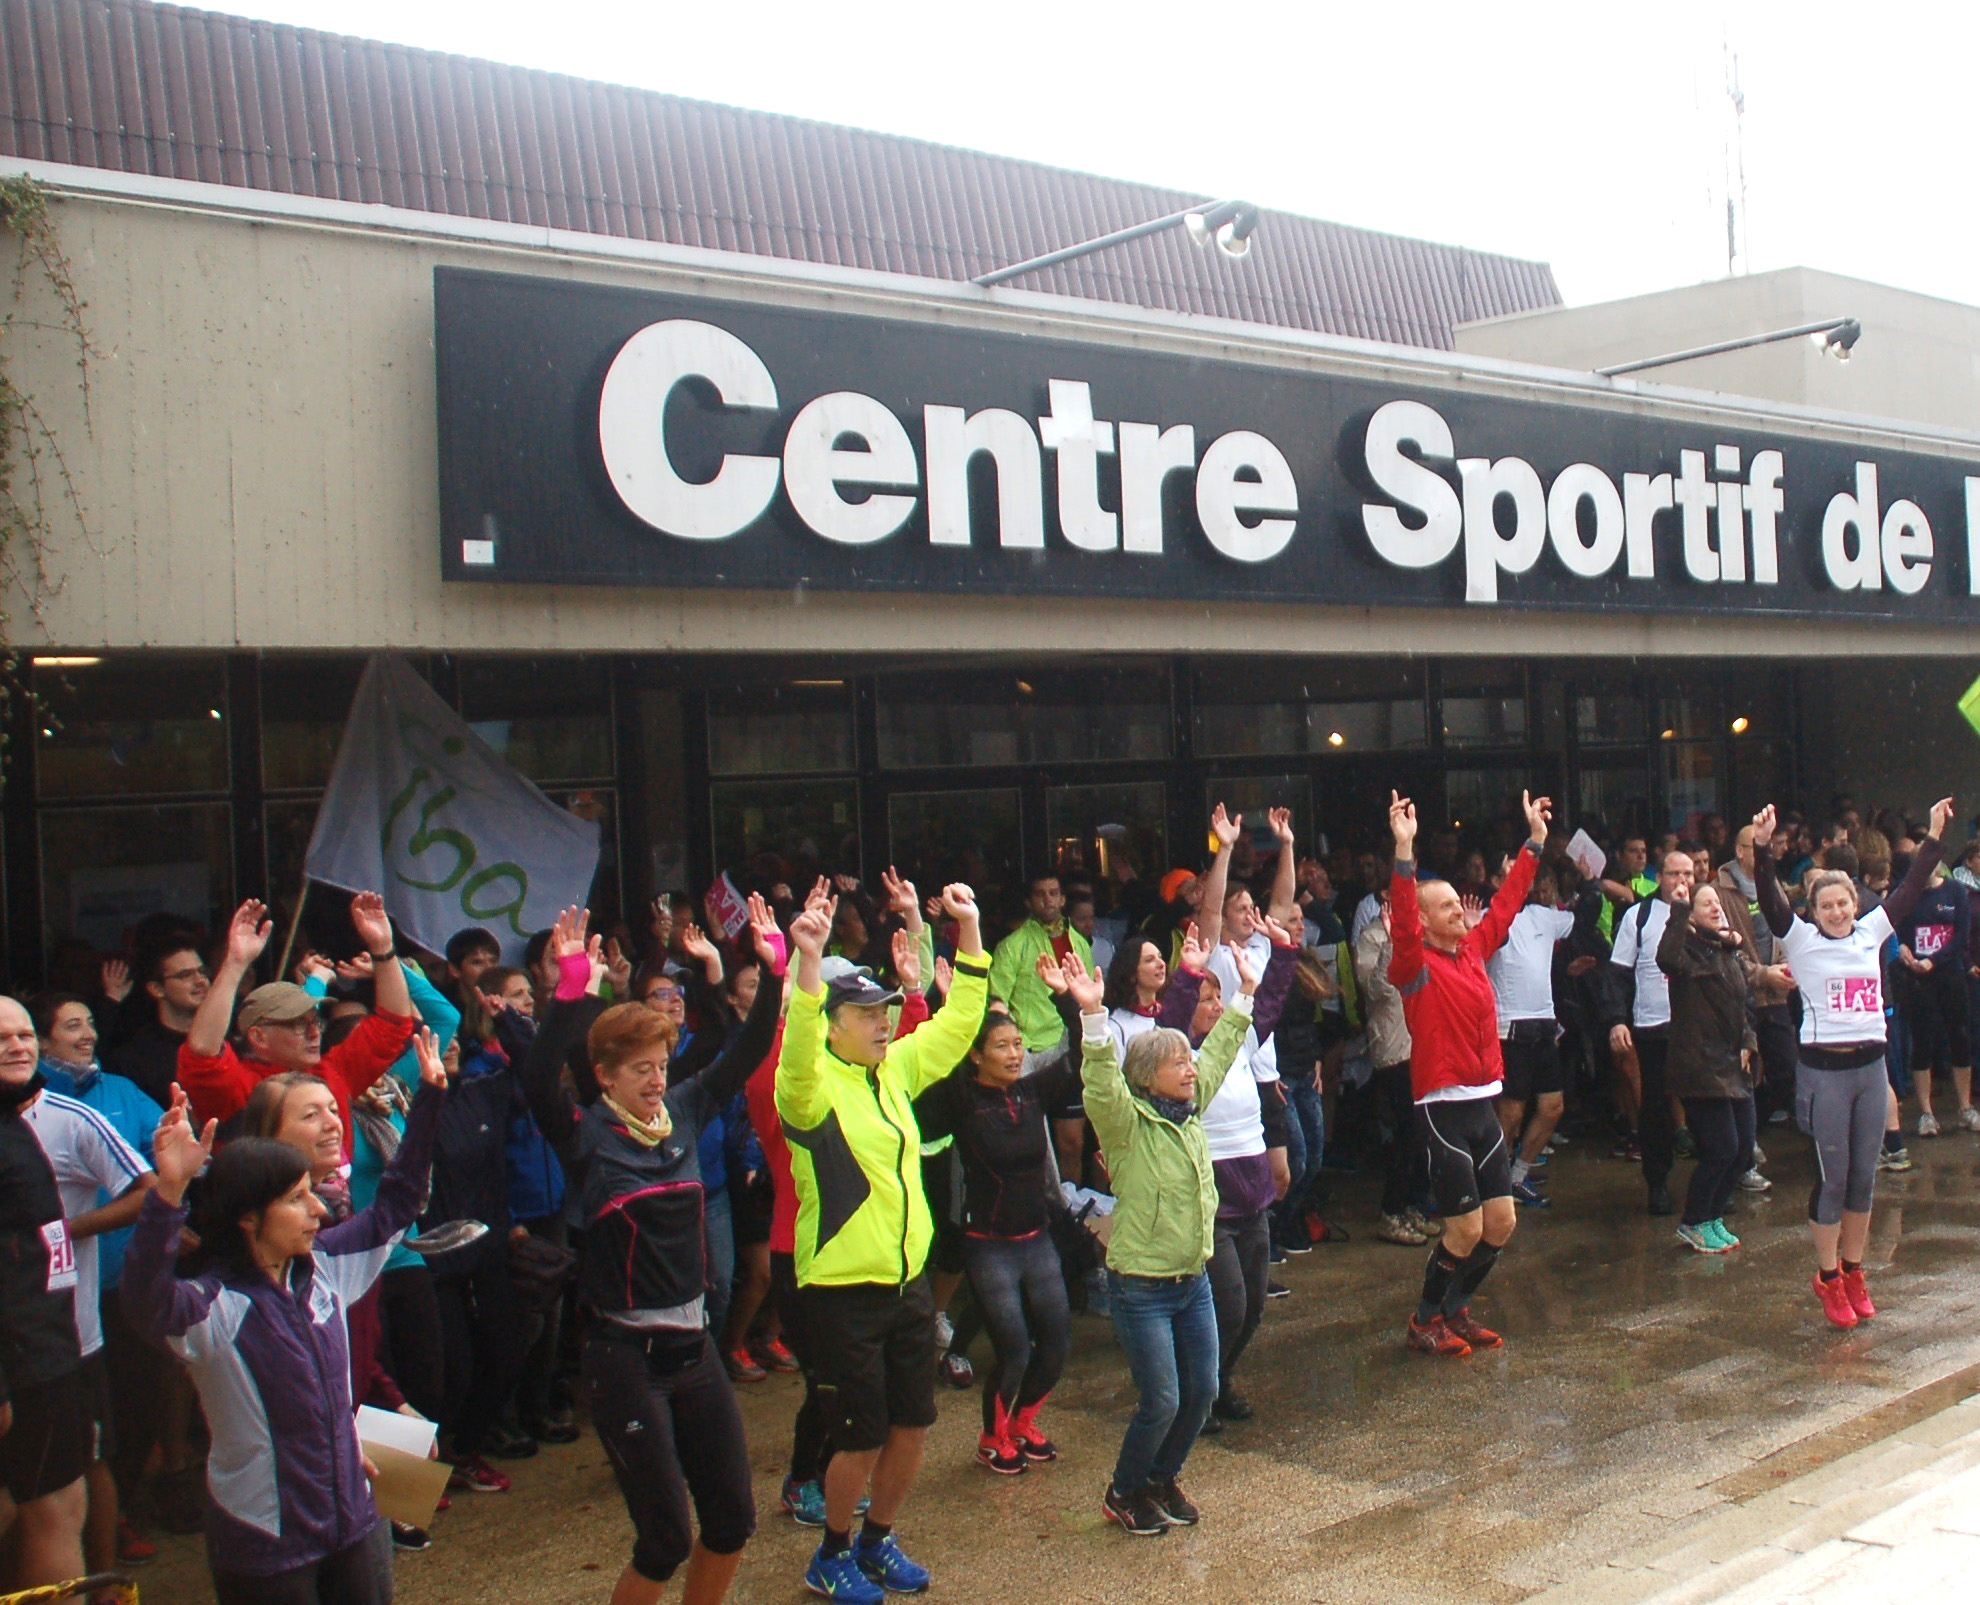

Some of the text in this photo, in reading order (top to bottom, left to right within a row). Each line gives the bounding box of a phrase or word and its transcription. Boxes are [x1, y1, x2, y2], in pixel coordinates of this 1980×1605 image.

[599, 318, 1299, 563] Centre
[1362, 400, 1785, 602] Sportif
[1822, 461, 1935, 594] de
[1915, 934, 1942, 949] ELA
[1827, 990, 1866, 1012] ELA
[49, 1242, 75, 1274] EL
